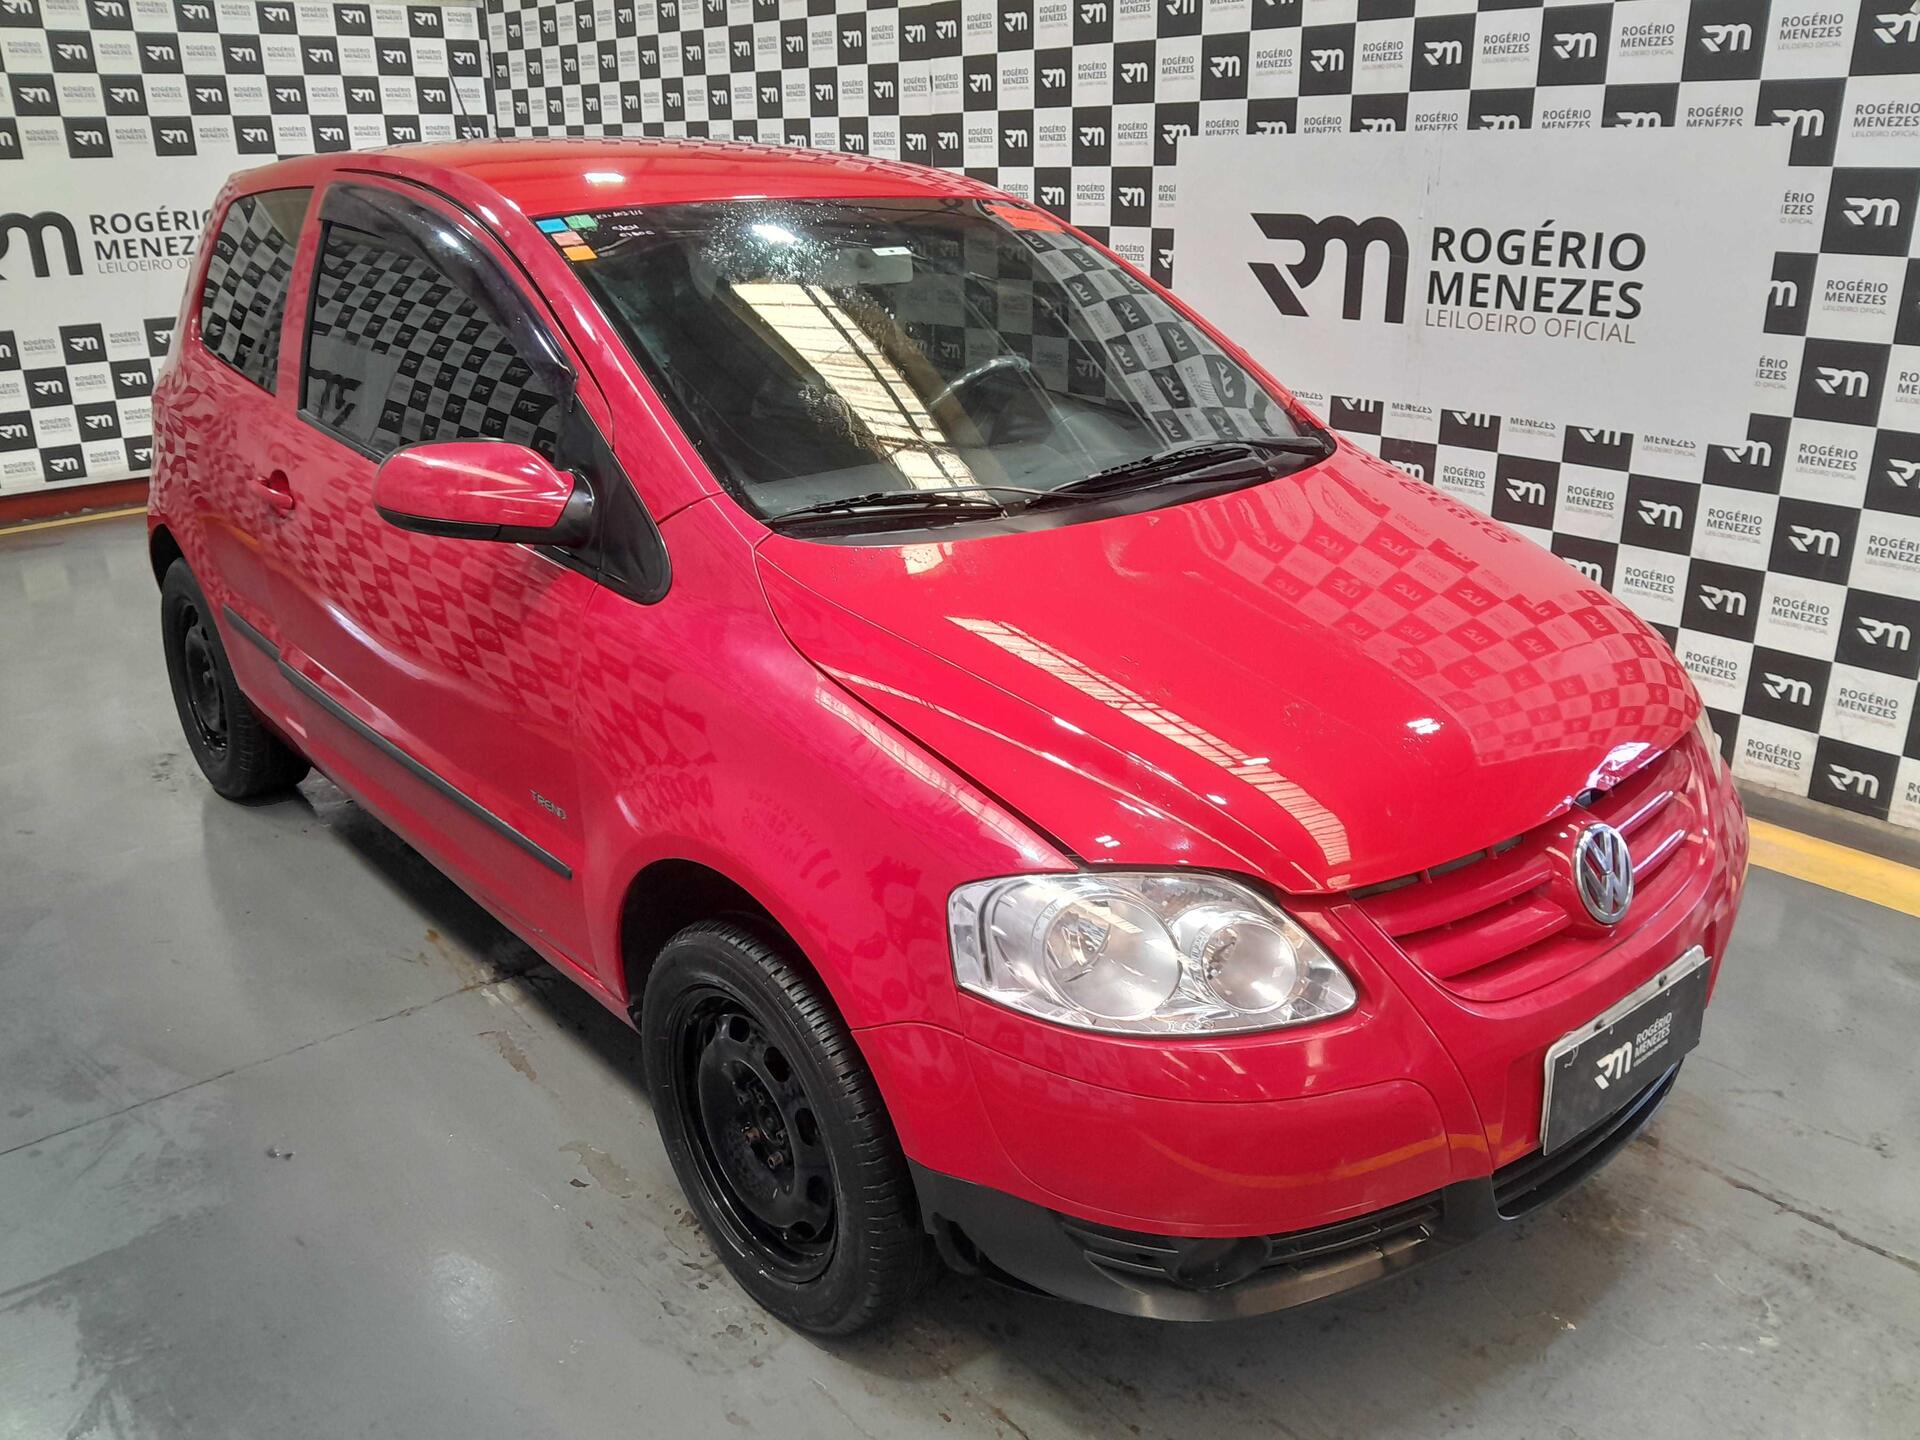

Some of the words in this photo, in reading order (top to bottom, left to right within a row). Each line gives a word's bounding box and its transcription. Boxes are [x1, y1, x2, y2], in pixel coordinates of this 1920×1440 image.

[1039, 4, 1067, 15] ROGÉRIO
[1120, 4, 1150, 14] MENEZES
[967, 13, 992, 22] ROGÉRIO
[1039, 13, 1067, 23] MENEZES
[1781, 12, 1844, 28] ROGÉRIO
[967, 21, 992, 31] MENEZES
[1621, 24, 1675, 36] ROGÉRIO
[1484, 32, 1530, 44] ROGÉRIO
[1780, 26, 1842, 40] MENEZES
[1362, 40, 1404, 52] ROGÉRIO
[1620, 35, 1674, 48] MENEZES
[1256, 48, 1292, 59] ROGÉRIO
[1482, 44, 1530, 55] MENEZES
[1162, 56, 1194, 65] ROGÉRIO
[1362, 51, 1403, 62] MENEZES
[1078, 62, 1107, 70] ROGÉRIO
[1162, 65, 1194, 74] MENEZES
[1256, 59, 1292, 68] MENEZES
[1002, 68, 1028, 76] ROGÉRIO
[1078, 70, 1107, 80] MENEZES
[1002, 75, 1029, 85] MENEZES
[1415, 112, 1458, 122] ROGÉRIO
[1542, 108, 1592, 120] ROGÉRIO
[1687, 104, 1743, 118] ROGÉRIO
[1118, 123, 1147, 131] ROGÉRIO
[1205, 119, 1239, 128] ROGÉRIO
[1304, 115, 1342, 126] ROGÉRIO
[1853, 115, 1920, 128] MENEZES
[968, 127, 993, 135] ROGÉRIO
[1039, 125, 1066, 133] ROGÉRIO
[1118, 131, 1148, 140] MENEZES
[968, 135, 993, 143] MENEZES
[1039, 133, 1067, 142] MENEZES
[1077, 183, 1105, 192] ROGÉRIO
[1077, 192, 1105, 200] MENEZES
[1784, 190, 1815, 203] ÉRIO
[95, 236, 200, 260] MENEZ
[1115, 245, 1144, 253] ROGÉRIO
[1430, 219, 1646, 271] ROGÉRIO
[98, 258, 172, 274] LEILOEIRO
[1826, 279, 1888, 293] ROGÉRIO
[1427, 271, 1645, 319] MENEZES
[1825, 292, 1887, 305] MENEZES
[1425, 309, 1537, 335] LEILOEIRO
[1544, 318, 1636, 344] OFICIAL
[1759, 355, 1788, 369] ÉRIO
[1799, 443, 1858, 459] ROGÉRIO
[1798, 455, 1857, 471] MENEZES
[1443, 465, 1485, 479] ROGÉRIO
[1442, 475, 1485, 488] MENEZES
[1568, 485, 1615, 500] ROGÉRIO
[1566, 495, 1614, 510] MENEZES
[1708, 508, 1763, 525] ROGÉRIO
[1707, 519, 1761, 536] MENEZES
[1869, 536, 1920, 552] ROGÉRI
[1867, 547, 1920, 564] MENEZE
[1626, 567, 1675, 584] ROGÉRIO
[1624, 577, 1674, 594] MENEZES
[1773, 596, 1829, 615] ROGÉRIO
[1771, 607, 1828, 626] MENEZES
[1686, 652, 1737, 671] ROGÉRIO
[1684, 661, 1736, 680] MENEZES
[1840, 688, 1898, 708] ROGÉRIO
[1838, 698, 1897, 719] MENEZES
[1748, 739, 1802, 760] ROGÉRIO
[1746, 749, 1800, 770] MENEZES
[1636, 1012, 1672, 1045] ROGÉRIO
[1635, 1024, 1670, 1058] MENEZES
